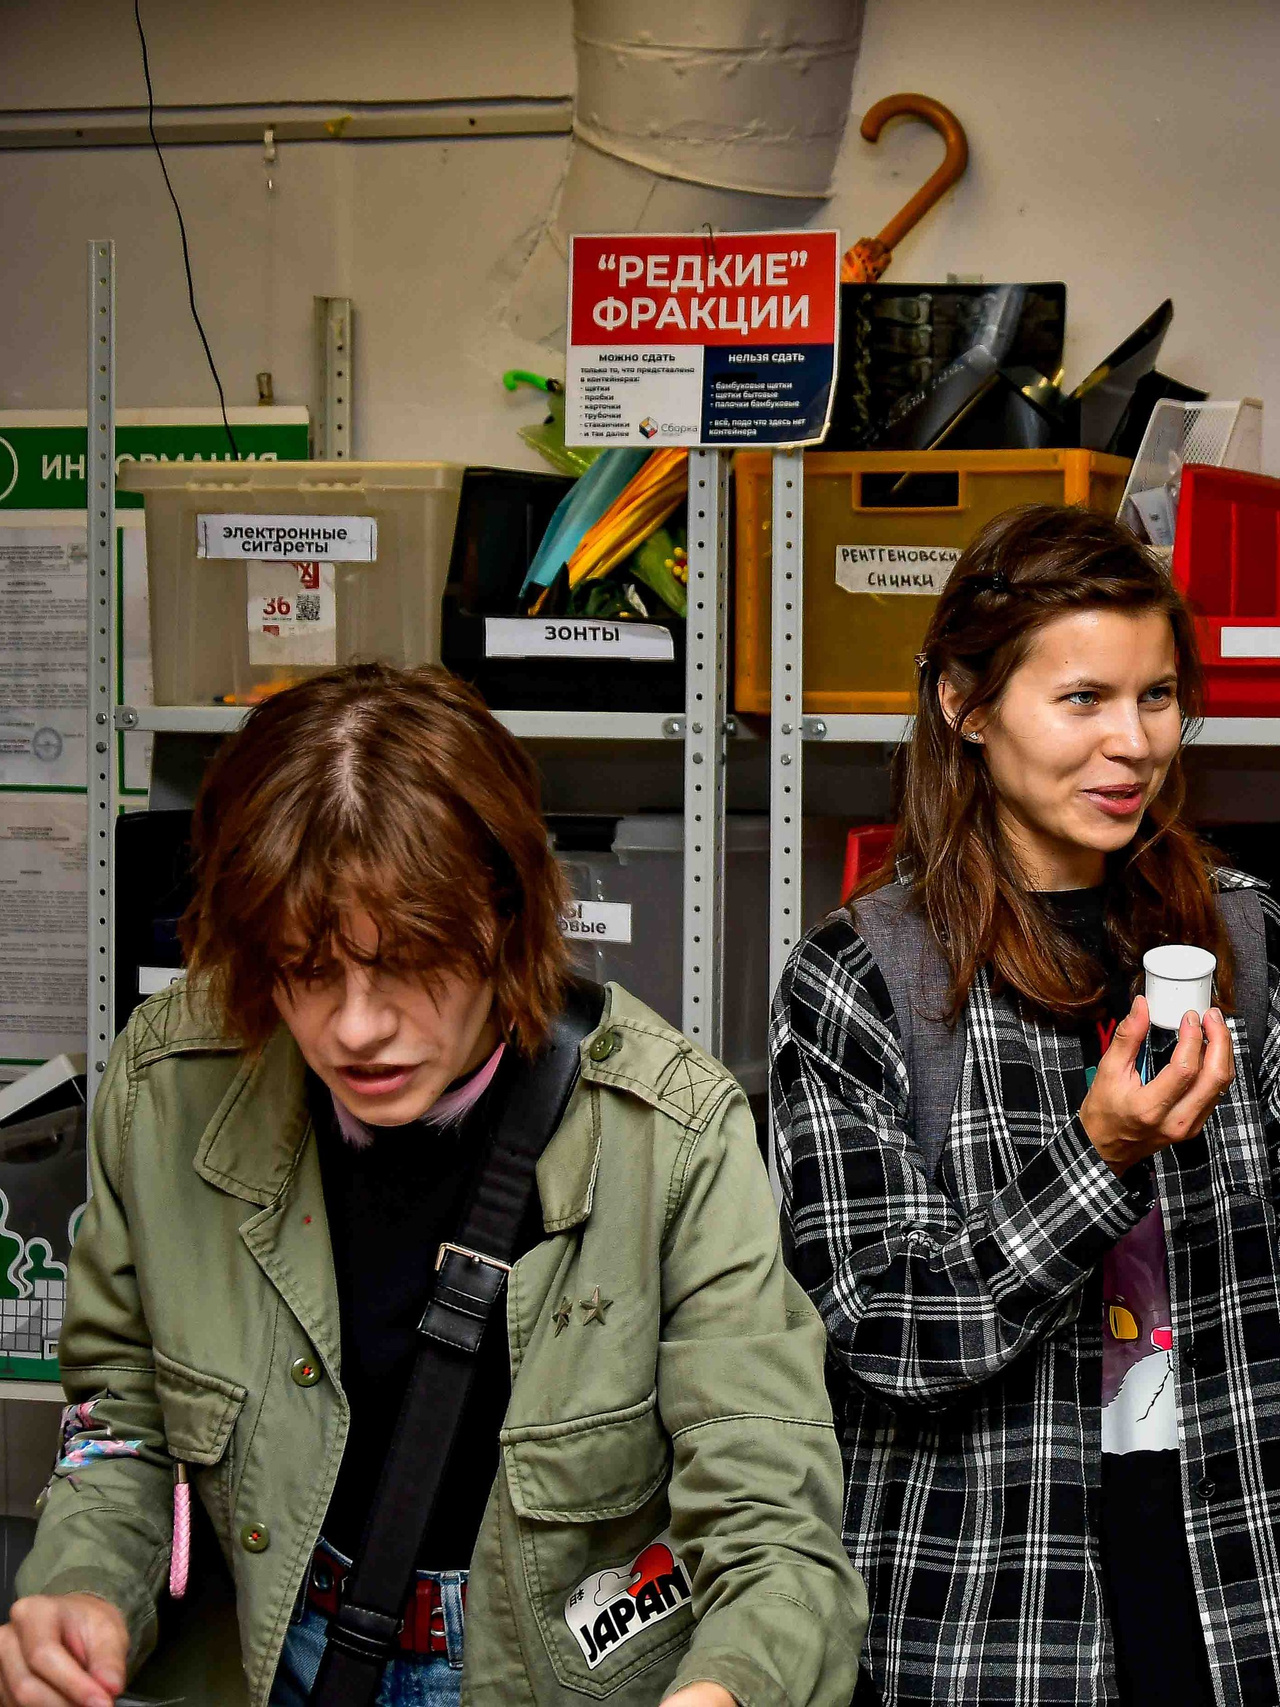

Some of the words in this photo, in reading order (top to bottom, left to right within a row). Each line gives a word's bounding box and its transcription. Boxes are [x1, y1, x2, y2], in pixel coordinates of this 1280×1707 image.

[592, 295, 809, 335] ФРАКЦИИ
[599, 354, 639, 363] можно
[642, 353, 676, 363] сдать
[728, 353, 769, 363] нельзя
[772, 352, 805, 363] сдать
[715, 382, 766, 390] бамбуковые
[584, 411, 621, 420] трубочки
[661, 423, 698, 433] Сборка
[709, 428, 757, 436] контейнера
[222, 526, 348, 542] электронные
[241, 539, 329, 555] сигареты
[842, 548, 958, 563] РЕНТГЕНОВСКИ
[868, 572, 934, 587] СНИМКИ
[561, 921, 607, 934] овые
[580, 1565, 692, 1663] JAPAN
